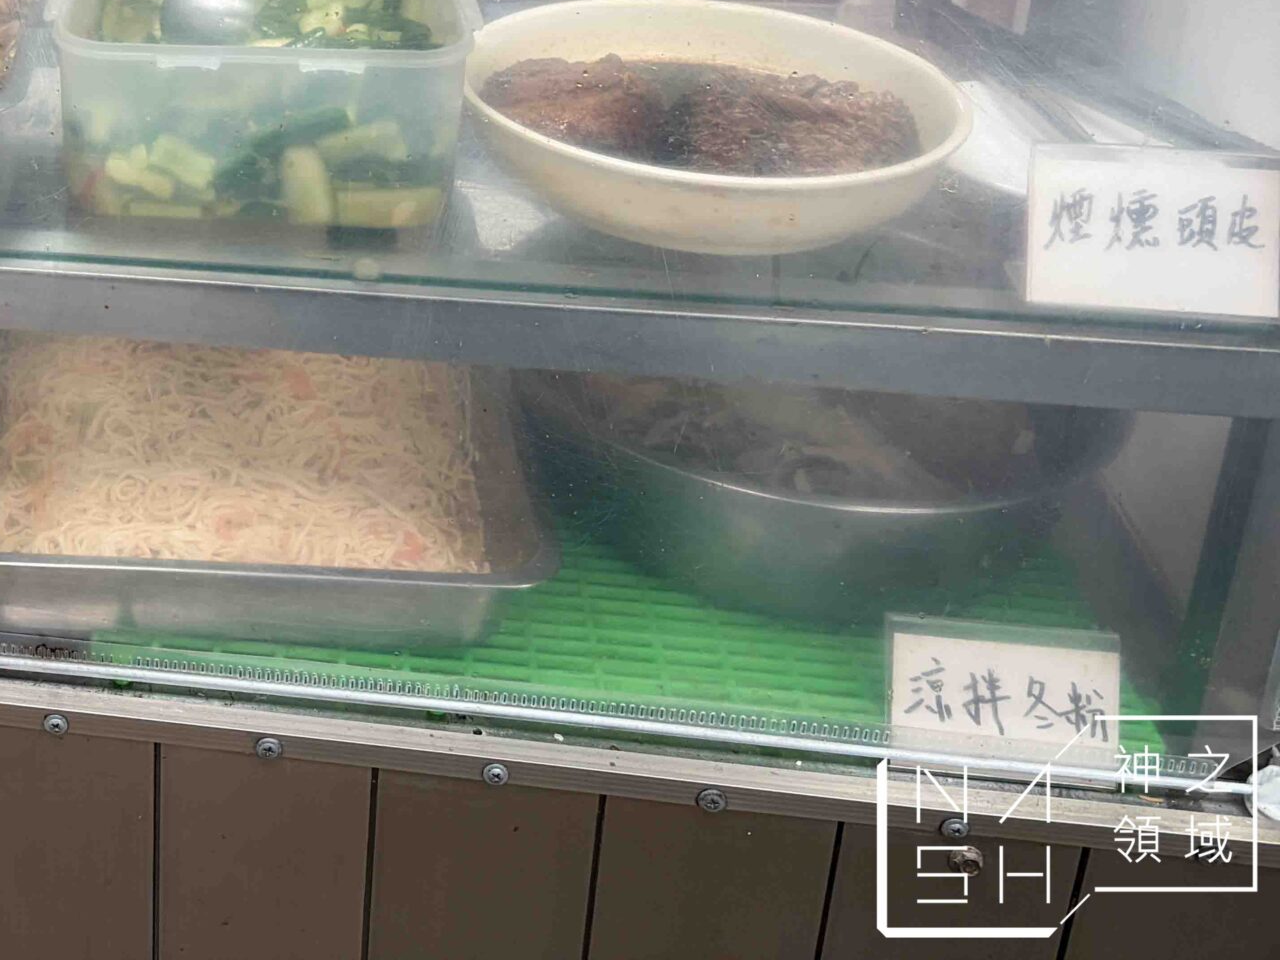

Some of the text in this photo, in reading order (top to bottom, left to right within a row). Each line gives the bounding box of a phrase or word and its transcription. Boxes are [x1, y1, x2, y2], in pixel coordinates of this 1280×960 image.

[1043, 188, 1266, 252] 煙燻頭皮
[904, 656, 1109, 742] 涼拌冬粉
